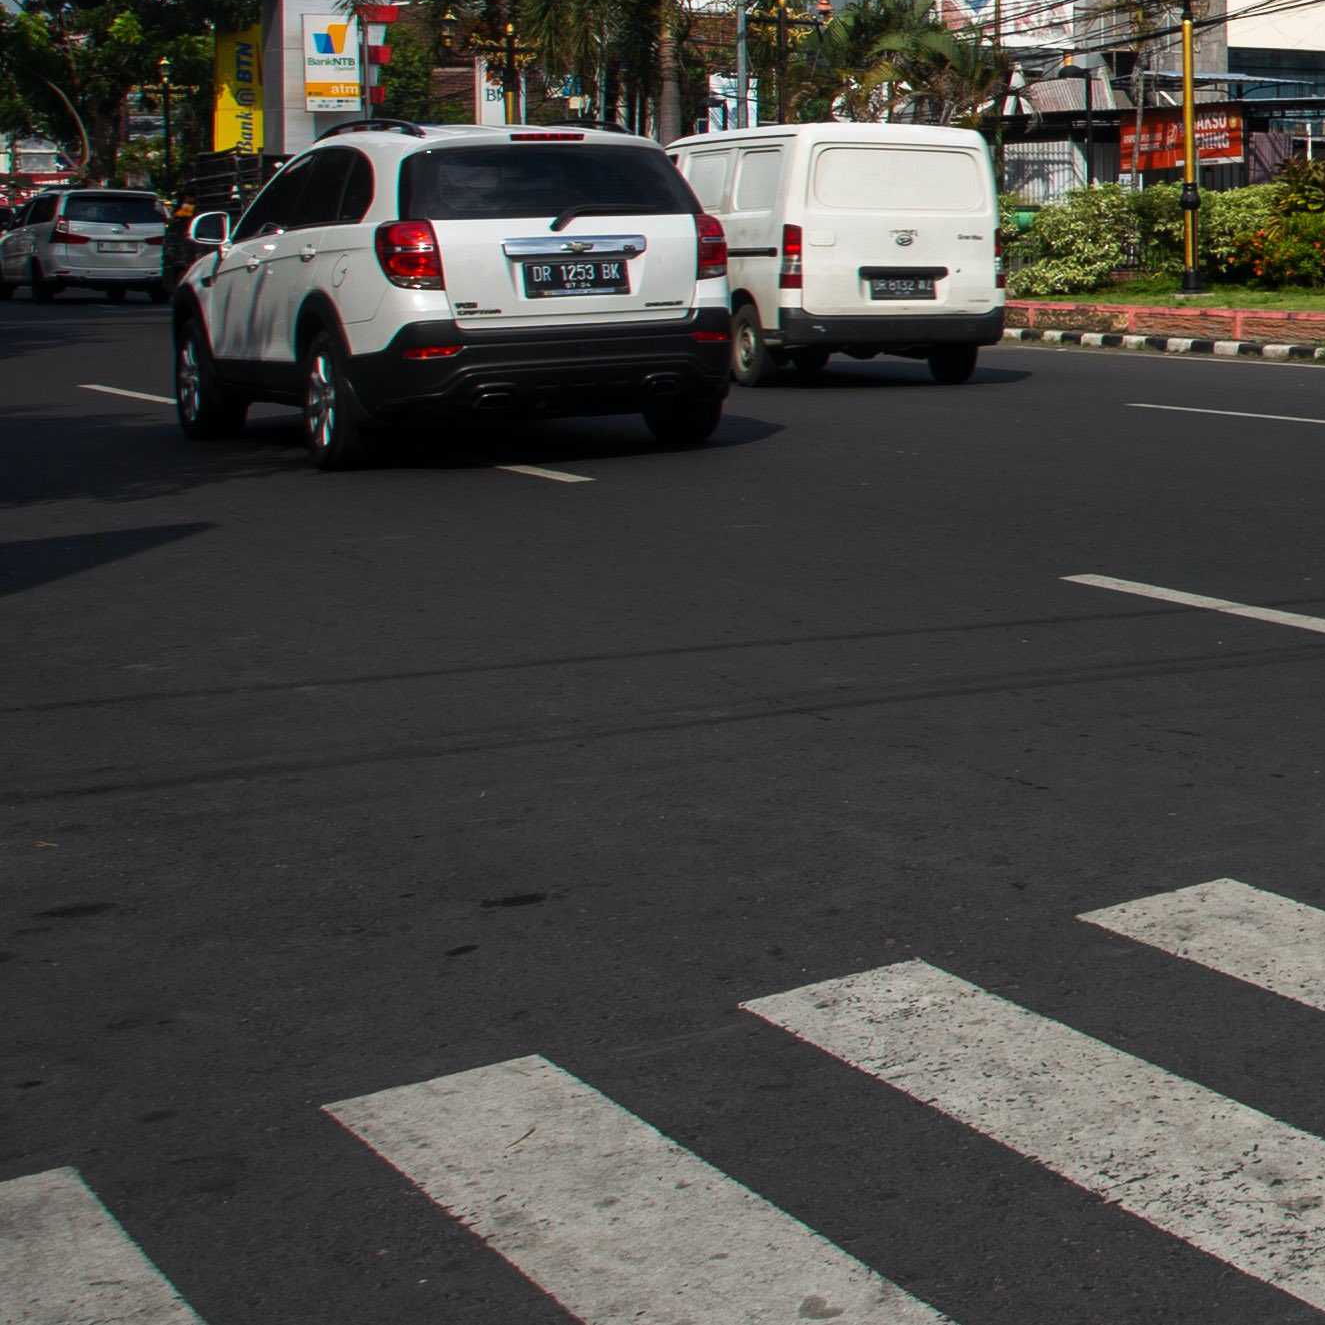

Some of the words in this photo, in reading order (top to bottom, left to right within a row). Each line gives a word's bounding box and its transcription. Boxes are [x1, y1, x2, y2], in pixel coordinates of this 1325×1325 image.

[236, 42, 253, 83] BTN
[330, 84, 360, 95] atm
[1193, 112, 1228, 131] AKSO
[236, 109, 254, 156] Bank
[532, 267, 551, 282] DR
[560, 264, 595, 281] 1253
[602, 263, 620, 279] BK
